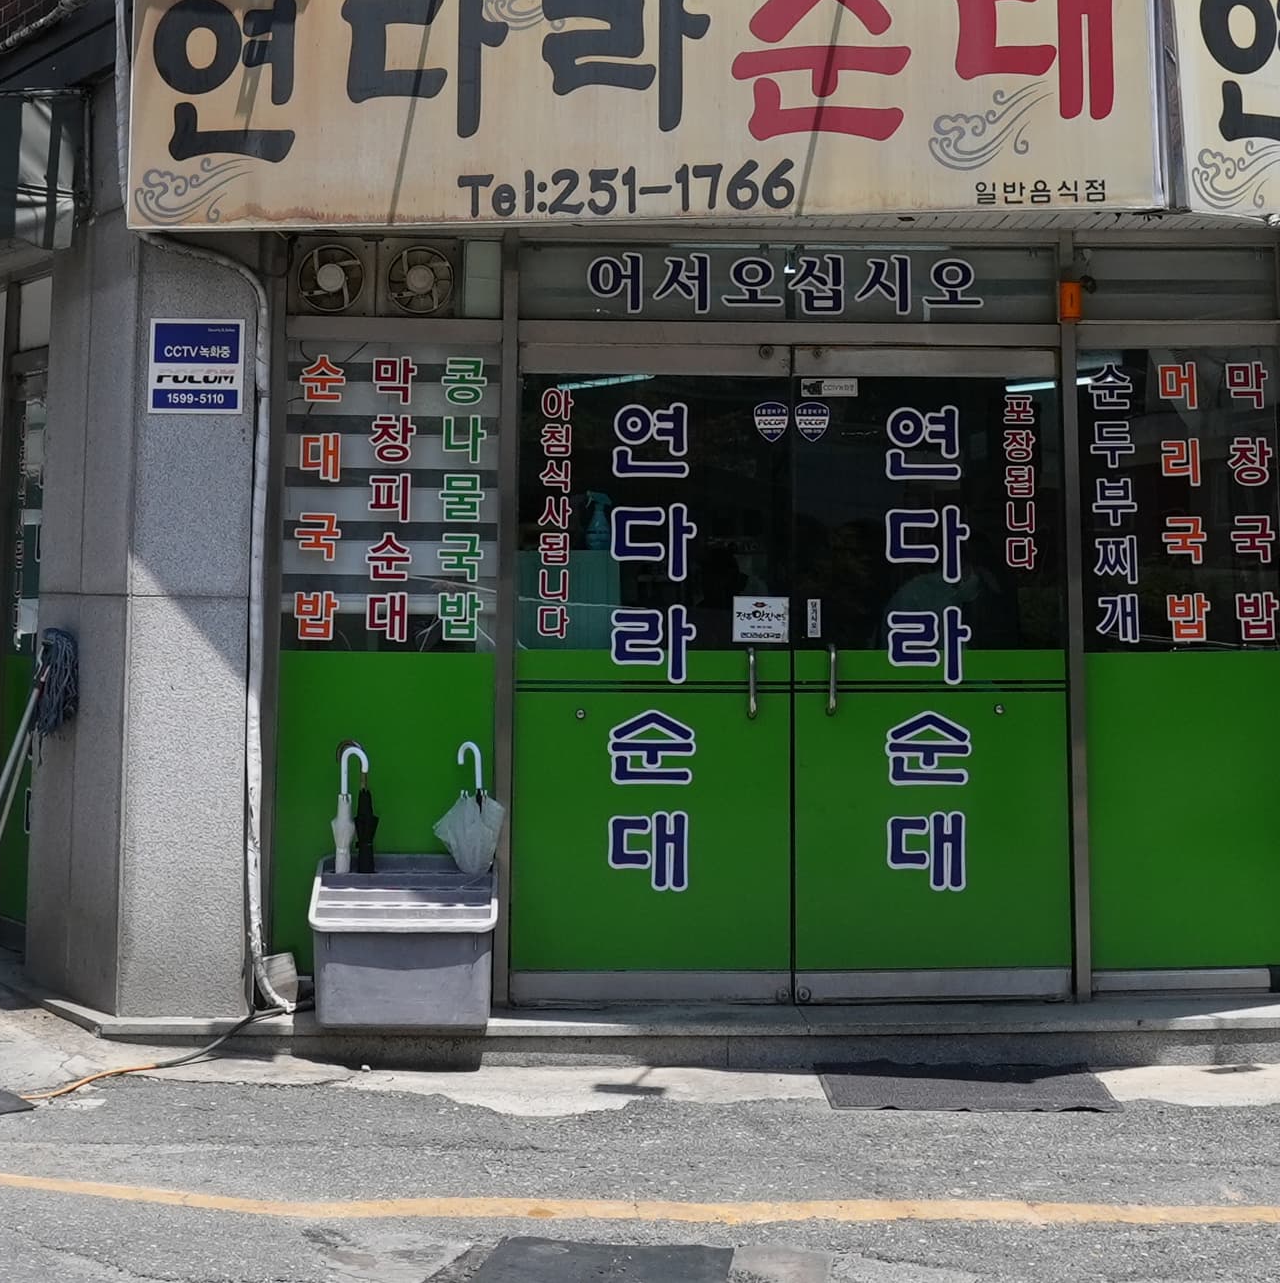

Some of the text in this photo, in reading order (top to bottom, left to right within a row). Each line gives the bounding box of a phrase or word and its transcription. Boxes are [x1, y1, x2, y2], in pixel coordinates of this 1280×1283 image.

[457, 158, 795, 218] Tel:251-1766
[587, 251, 984, 316] 어서오십시오
[975, 179, 1107, 205] 일반음식점
[166, 392, 225, 405] 1599-5110
[293, 354, 346, 642] 순대국밥
[365, 356, 417, 643] 막창피순대
[437, 356, 487, 642] 콩나물국밥
[1003, 393, 1037, 570] 포장됩니다
[1089, 361, 1141, 643] 순두부찌개
[1157, 361, 1211, 643] 머리국밥
[1225, 361, 1280, 642] 막창국밥
